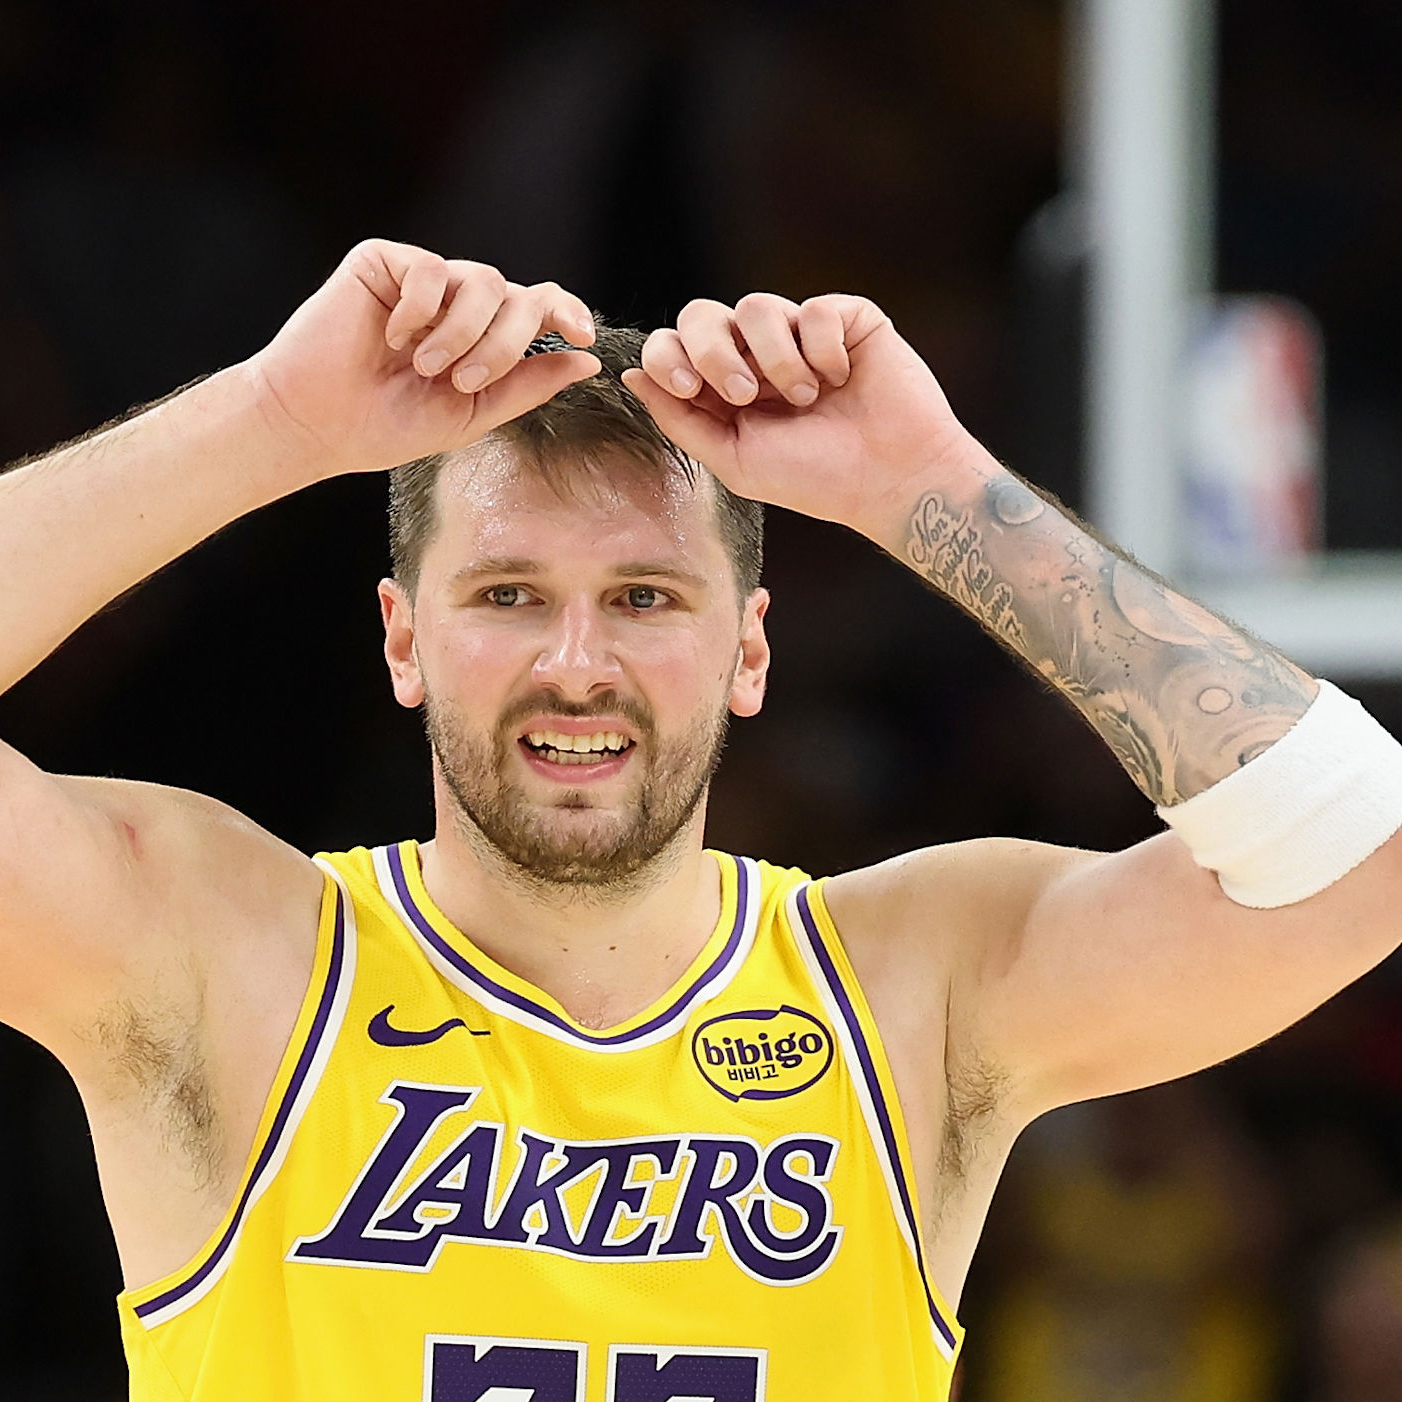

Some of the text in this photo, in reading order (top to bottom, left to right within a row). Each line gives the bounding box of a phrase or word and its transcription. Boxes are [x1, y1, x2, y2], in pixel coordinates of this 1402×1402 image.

[912, 497, 948, 564] Non
[959, 548, 990, 607] Non
[701, 1031, 824, 1069] bibigo
[726, 1063, 780, 1083] 비비고
[284, 1079, 845, 1288] LAKERS
